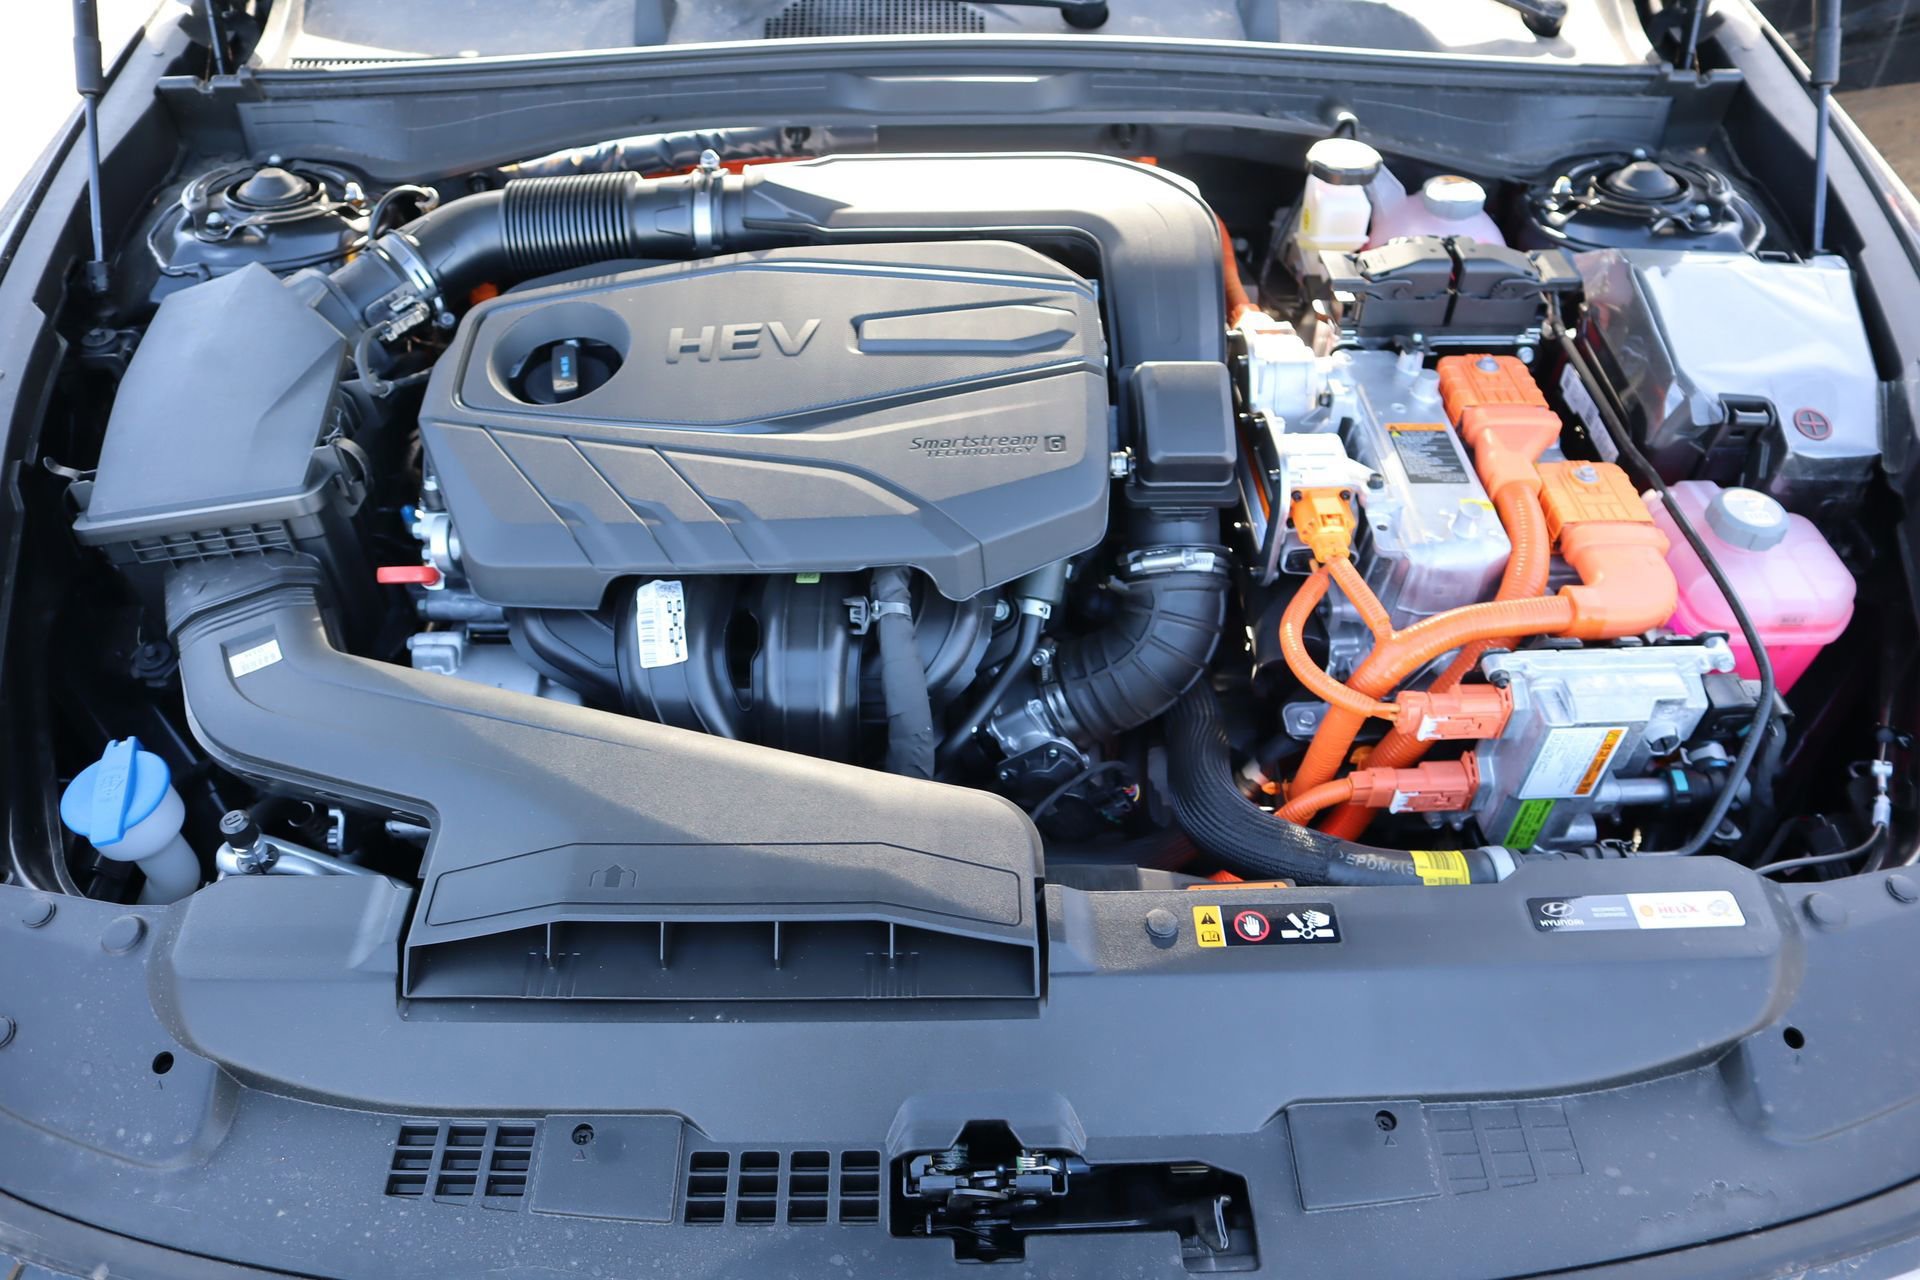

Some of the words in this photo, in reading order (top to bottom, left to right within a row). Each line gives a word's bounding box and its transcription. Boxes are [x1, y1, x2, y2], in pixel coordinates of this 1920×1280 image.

[666, 318, 821, 364] HEV
[909, 434, 1038, 449] Smartstream
[1045, 435, 1066, 452] G
[926, 446, 1034, 458] TECHNOLOGY
[1540, 919, 1584, 927] HYUNDAI
